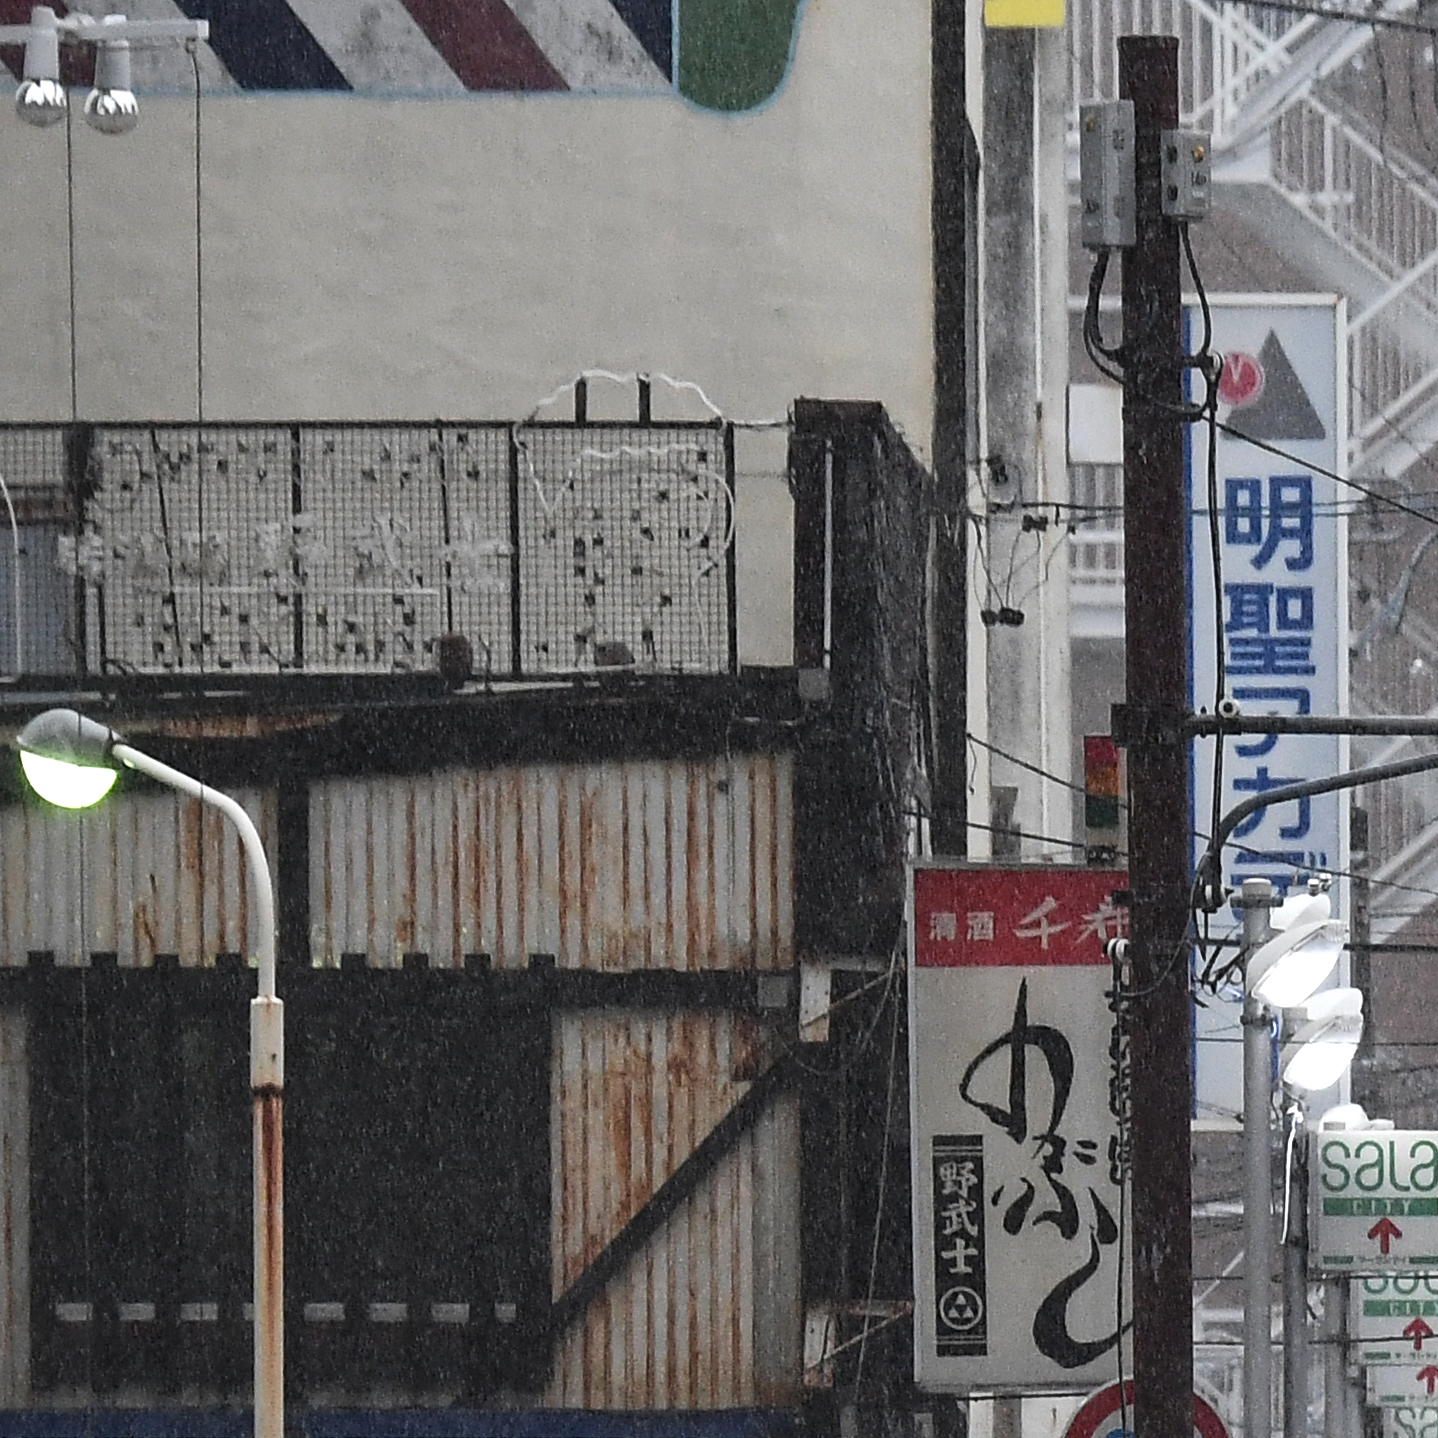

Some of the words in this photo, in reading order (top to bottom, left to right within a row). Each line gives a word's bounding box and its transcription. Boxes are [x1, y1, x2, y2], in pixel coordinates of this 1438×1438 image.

[1321, 1140, 1438, 1191] sala
[939, 1162, 979, 1275] 野武士
